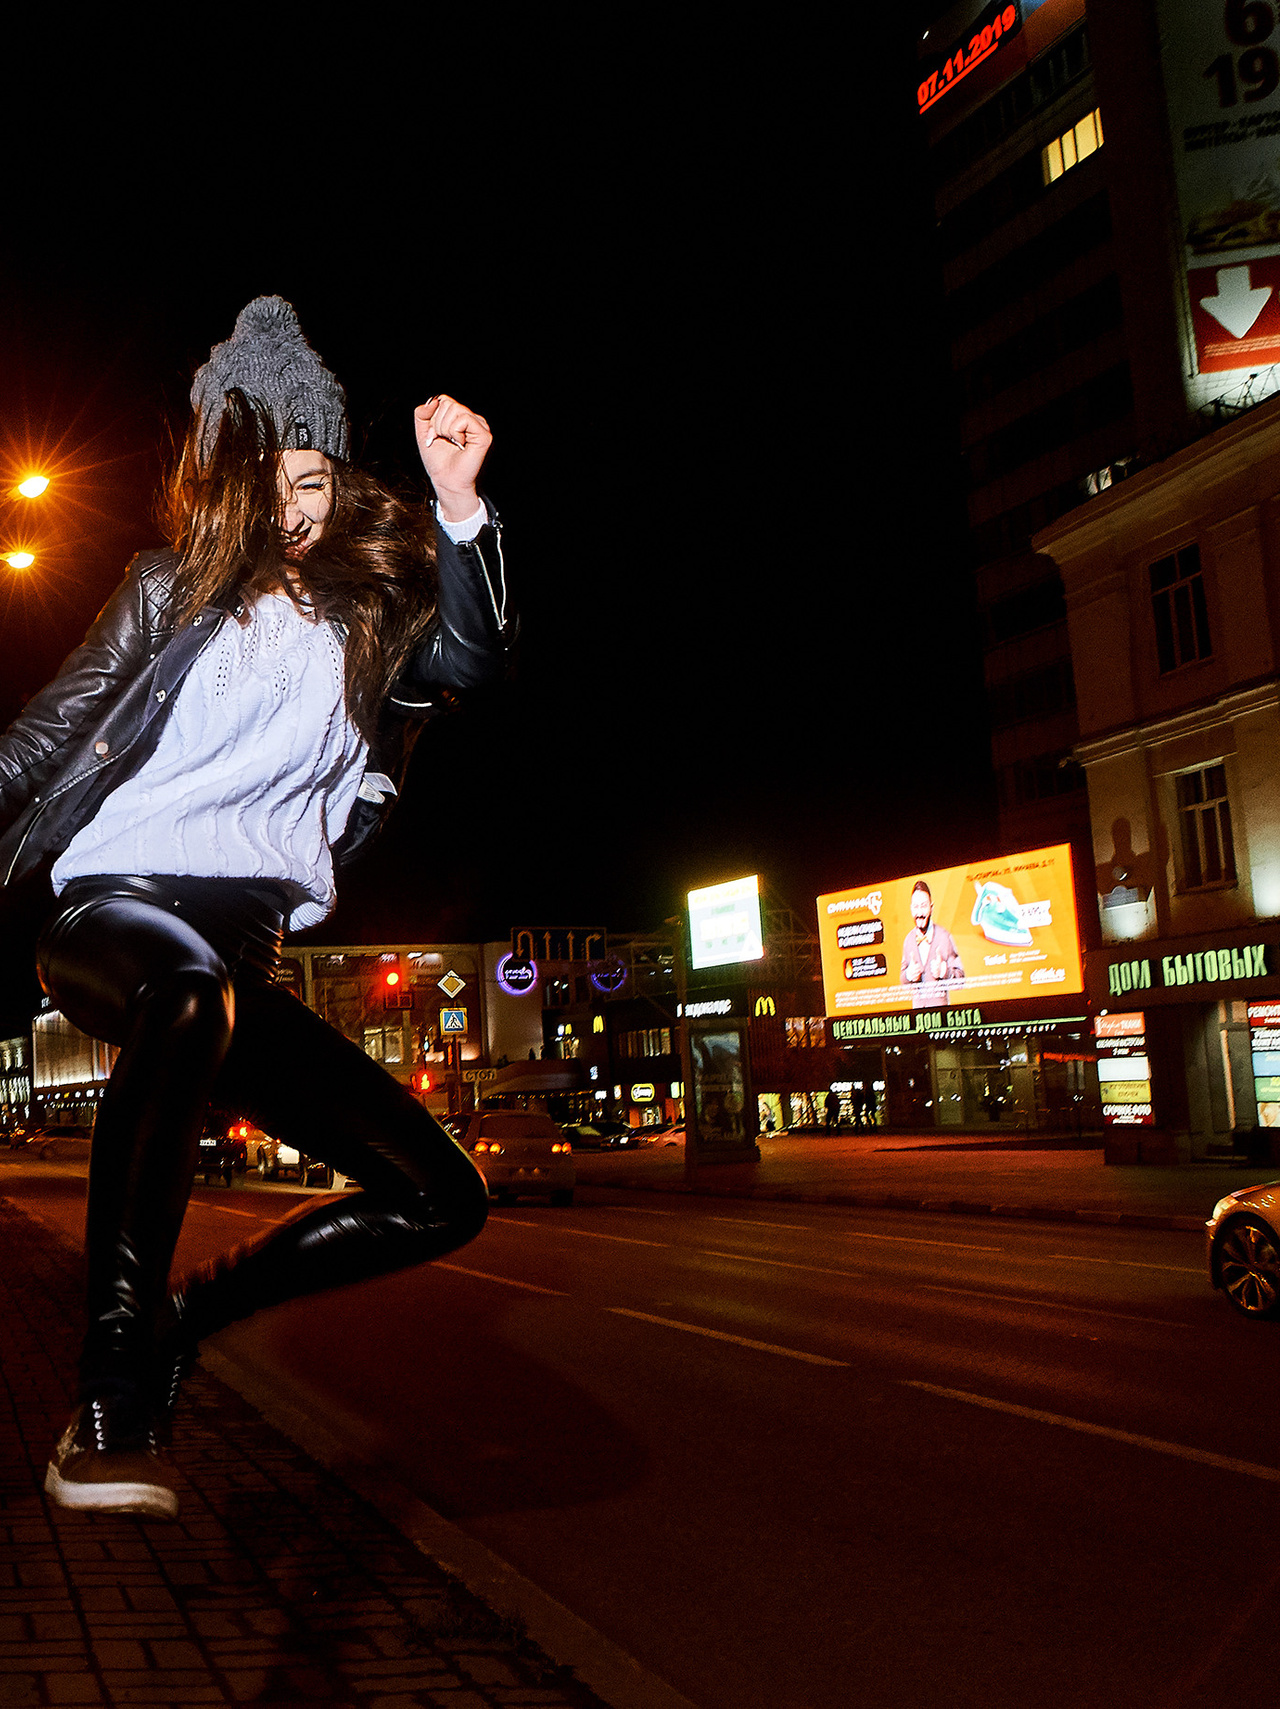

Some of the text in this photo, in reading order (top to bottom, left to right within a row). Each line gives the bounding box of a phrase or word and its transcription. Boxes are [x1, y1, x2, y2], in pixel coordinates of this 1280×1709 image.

[917, 4, 1016, 106] 07.11.2019
[1108, 959, 1151, 997] ДОМ
[1162, 943, 1268, 987] БЫТОВЫХ
[832, 1008, 982, 1040] ЦЕНТРАЛЬНЫЙ ДОМ БЫТА
